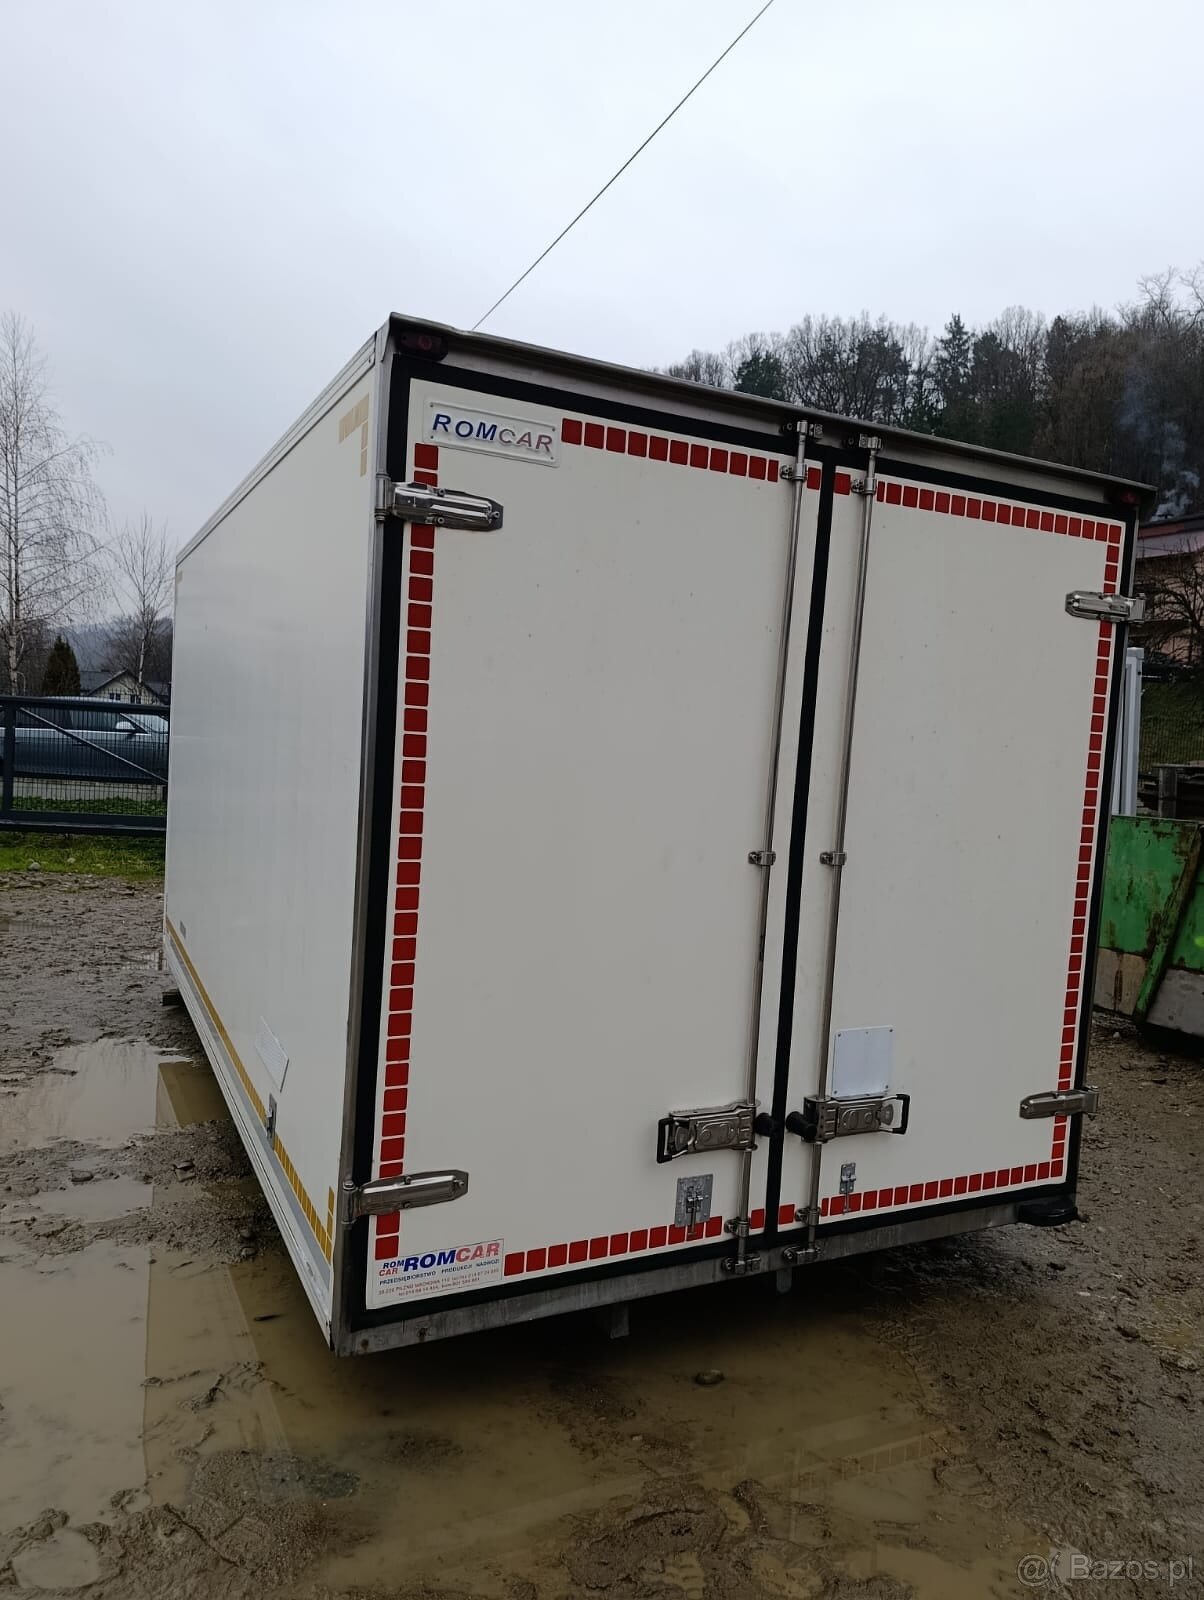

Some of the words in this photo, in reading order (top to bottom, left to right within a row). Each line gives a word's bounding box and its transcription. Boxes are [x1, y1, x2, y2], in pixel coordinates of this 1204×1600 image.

[432, 413, 553, 453] ROMCAR
[382, 1259, 405, 1269] ROM
[403, 1242, 500, 1272] ROMCAR
[379, 1267, 398, 1277] CAR
